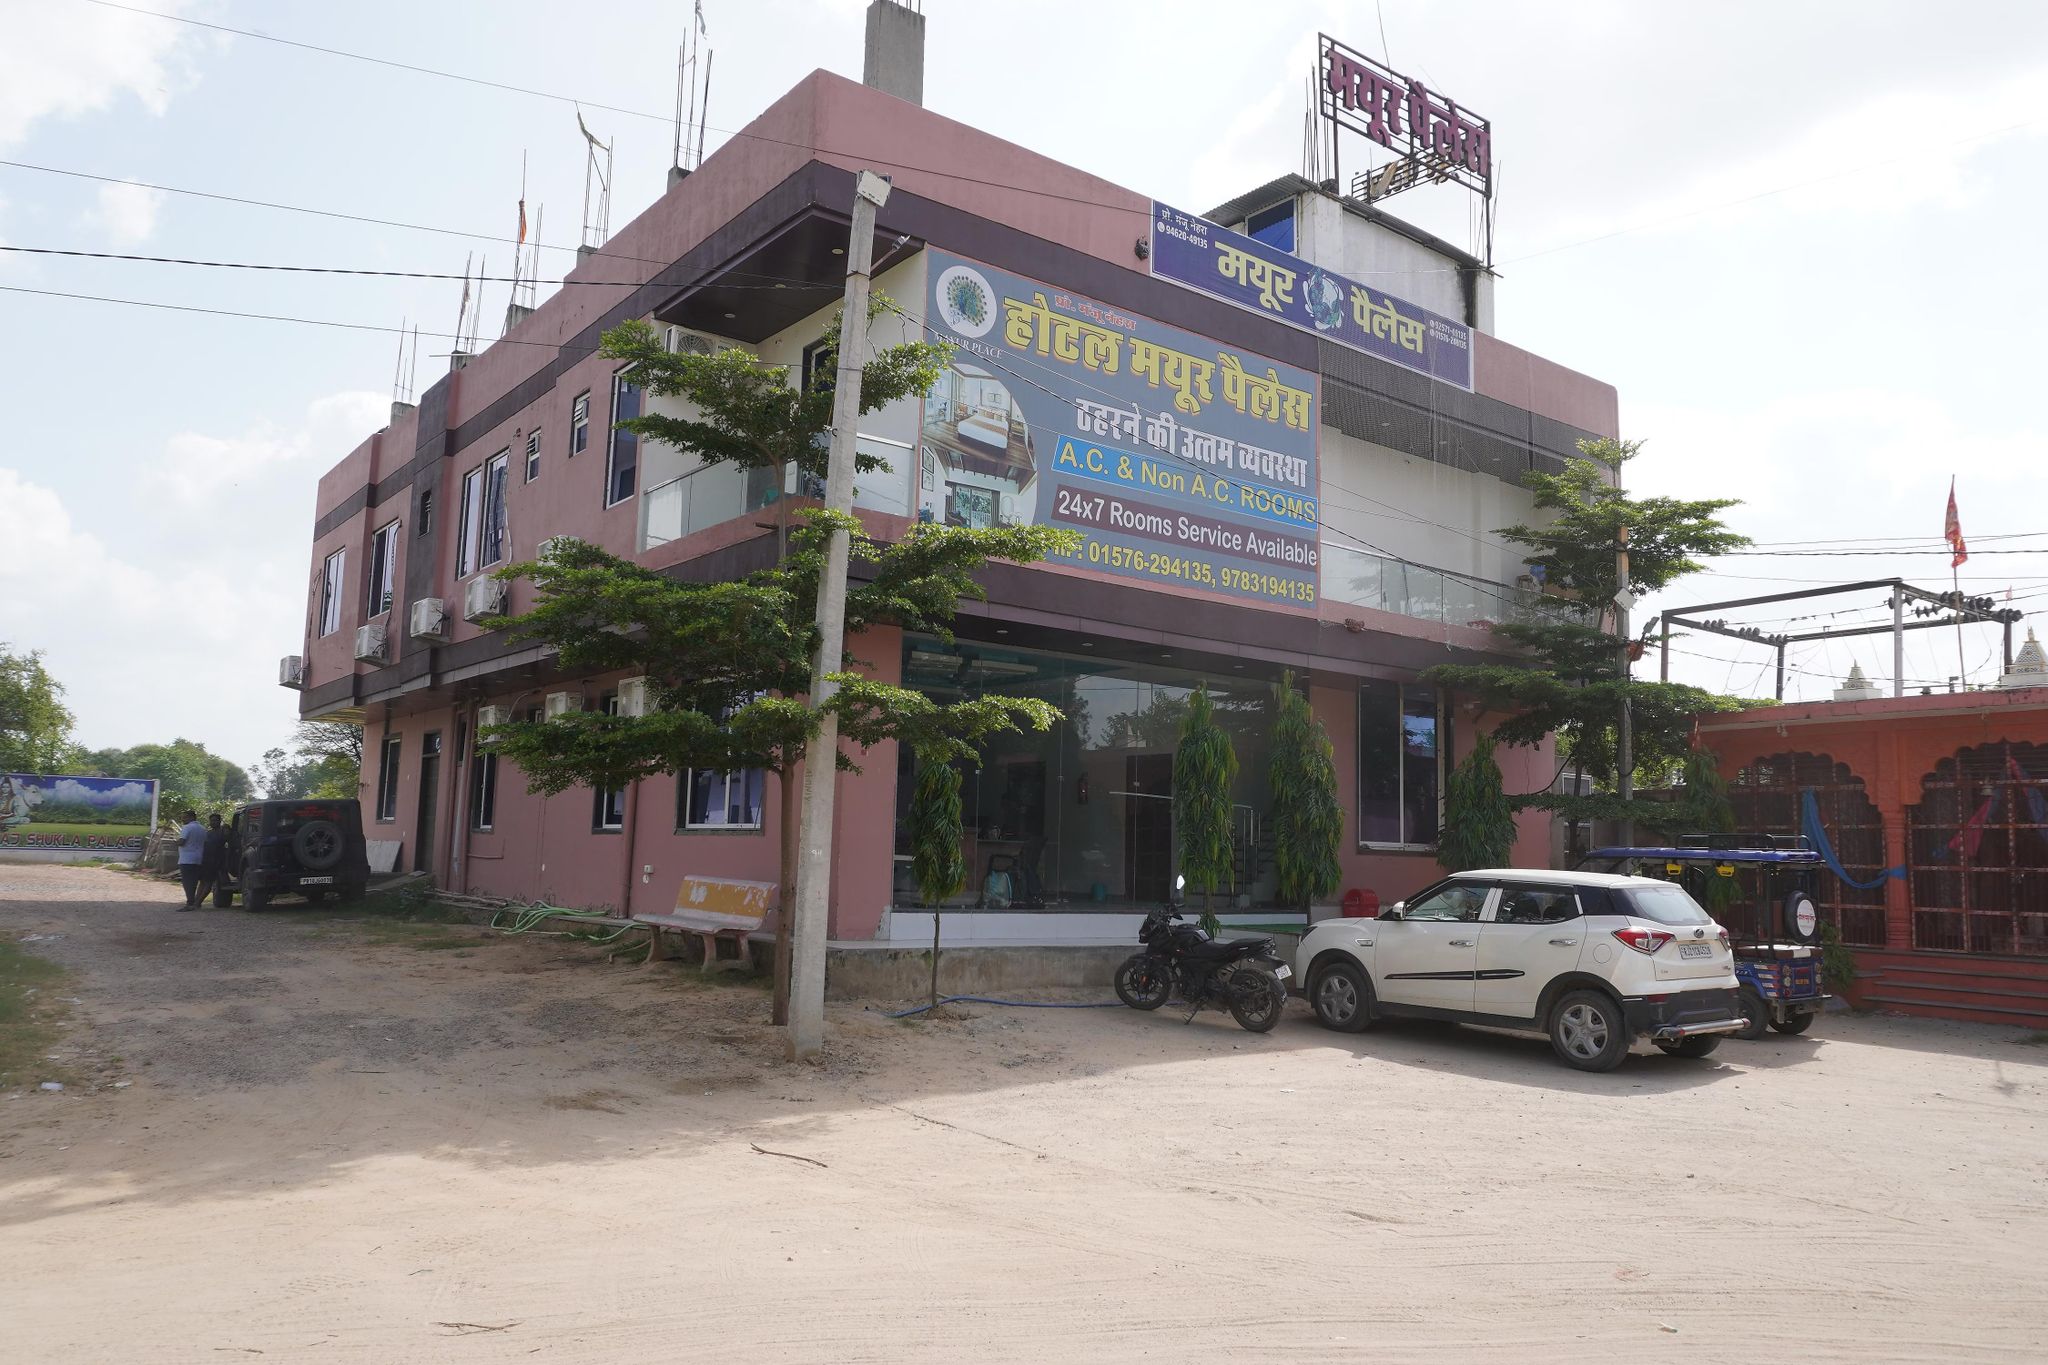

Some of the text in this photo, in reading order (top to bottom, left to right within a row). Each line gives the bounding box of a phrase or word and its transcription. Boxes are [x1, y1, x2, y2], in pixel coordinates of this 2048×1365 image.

[1325, 49, 1490, 177] मयूर पैलेस
[1165, 225, 1208, 249] 94620-49135
[1215, 240, 1426, 354] मयूर पैलेस
[971, 342, 1003, 359] PLACE
[1003, 292, 1313, 433] होटल मयूर पैलेस
[1059, 441, 1317, 523] A.C. & Non A.C. ROOMS
[1076, 396, 1140, 446] ठहरने
[1145, 410, 1178, 456] की
[1238, 441, 1308, 489] व्यवस्था
[1058, 489, 1318, 567] 24x7 Rooms Service Available
[1089, 541, 1216, 587] 01576-294135,
[1221, 567, 1315, 603] 9783194135
[26, 832, 81, 848] SHUKLA
[87, 834, 143, 849] PALACE
